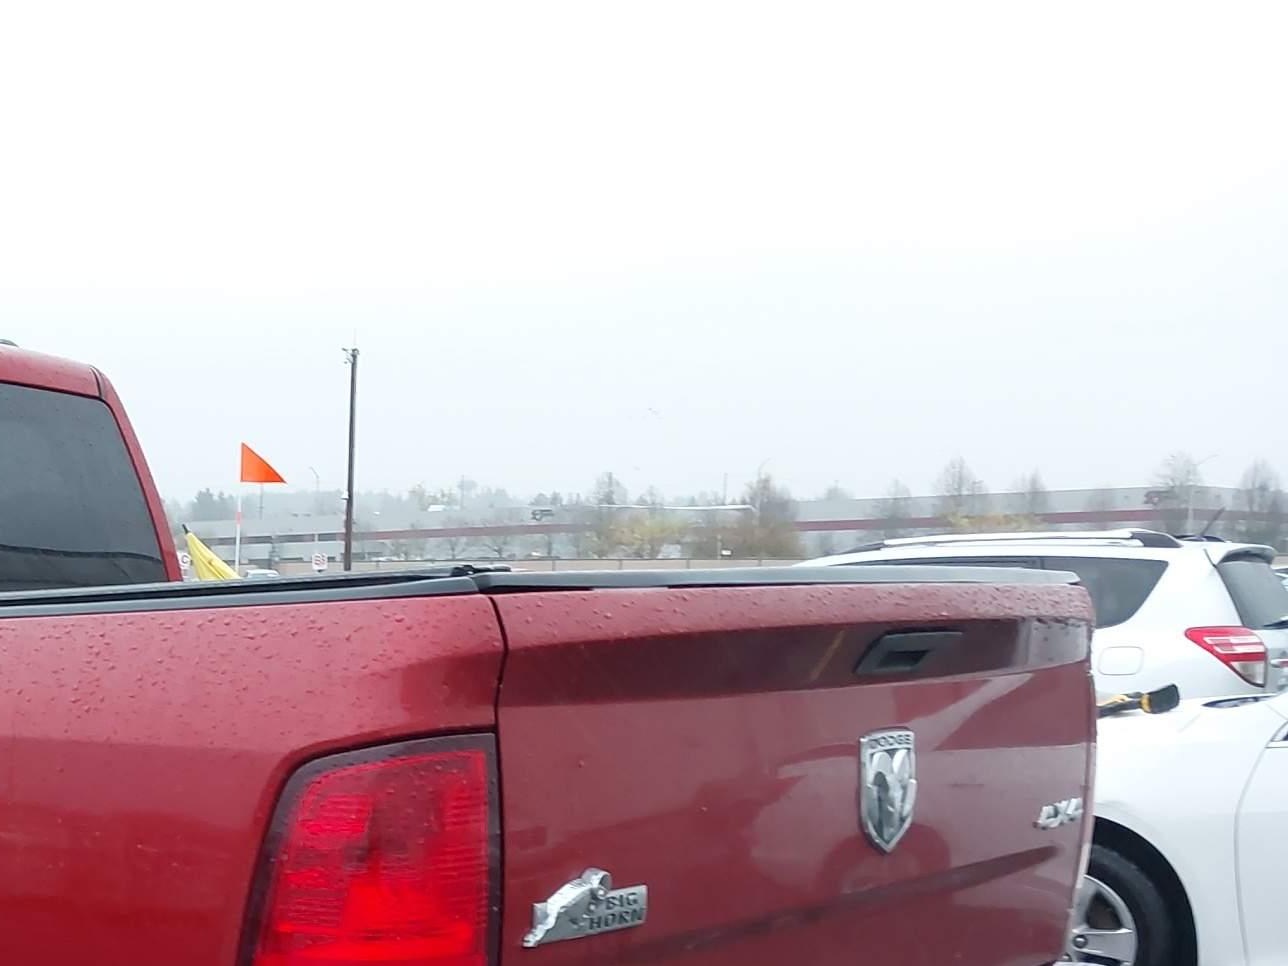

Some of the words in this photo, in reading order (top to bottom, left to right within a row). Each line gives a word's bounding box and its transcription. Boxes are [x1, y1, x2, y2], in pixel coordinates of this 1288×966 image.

[868, 734, 912, 749] DODGE
[605, 892, 639, 910] BIG
[588, 907, 644, 930] HORN
